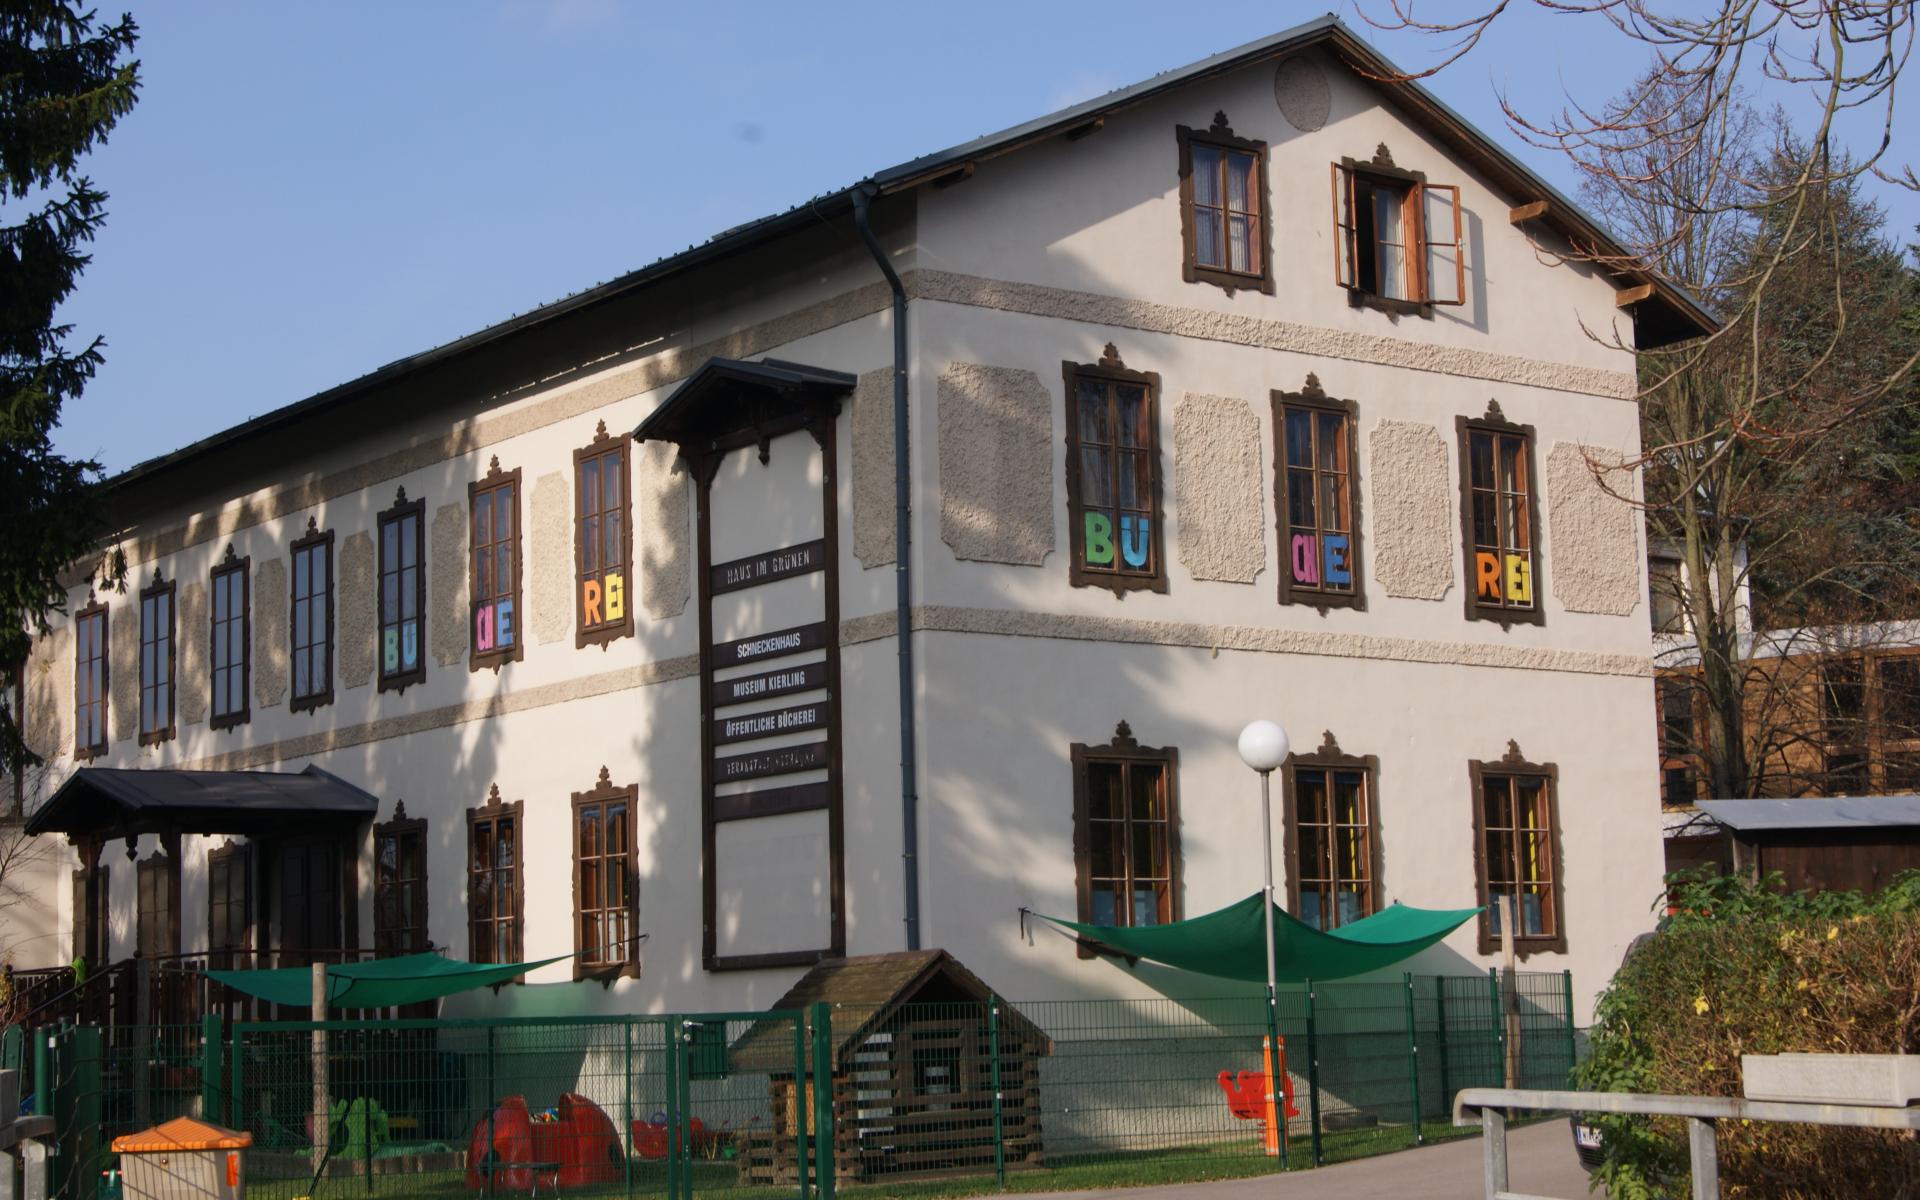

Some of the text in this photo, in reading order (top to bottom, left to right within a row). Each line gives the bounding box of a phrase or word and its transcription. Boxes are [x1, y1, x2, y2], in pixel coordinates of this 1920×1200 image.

[1084, 510, 1149, 567] BU
[727, 549, 810, 585] HAUS IM GRÜNEN
[737, 632, 801, 659] SCHNECKENHAUS
[733, 670, 805, 697] MUSEUM KIERLING
[726, 708, 816, 737] ÖFFENTLICHE BÜCHEREI
